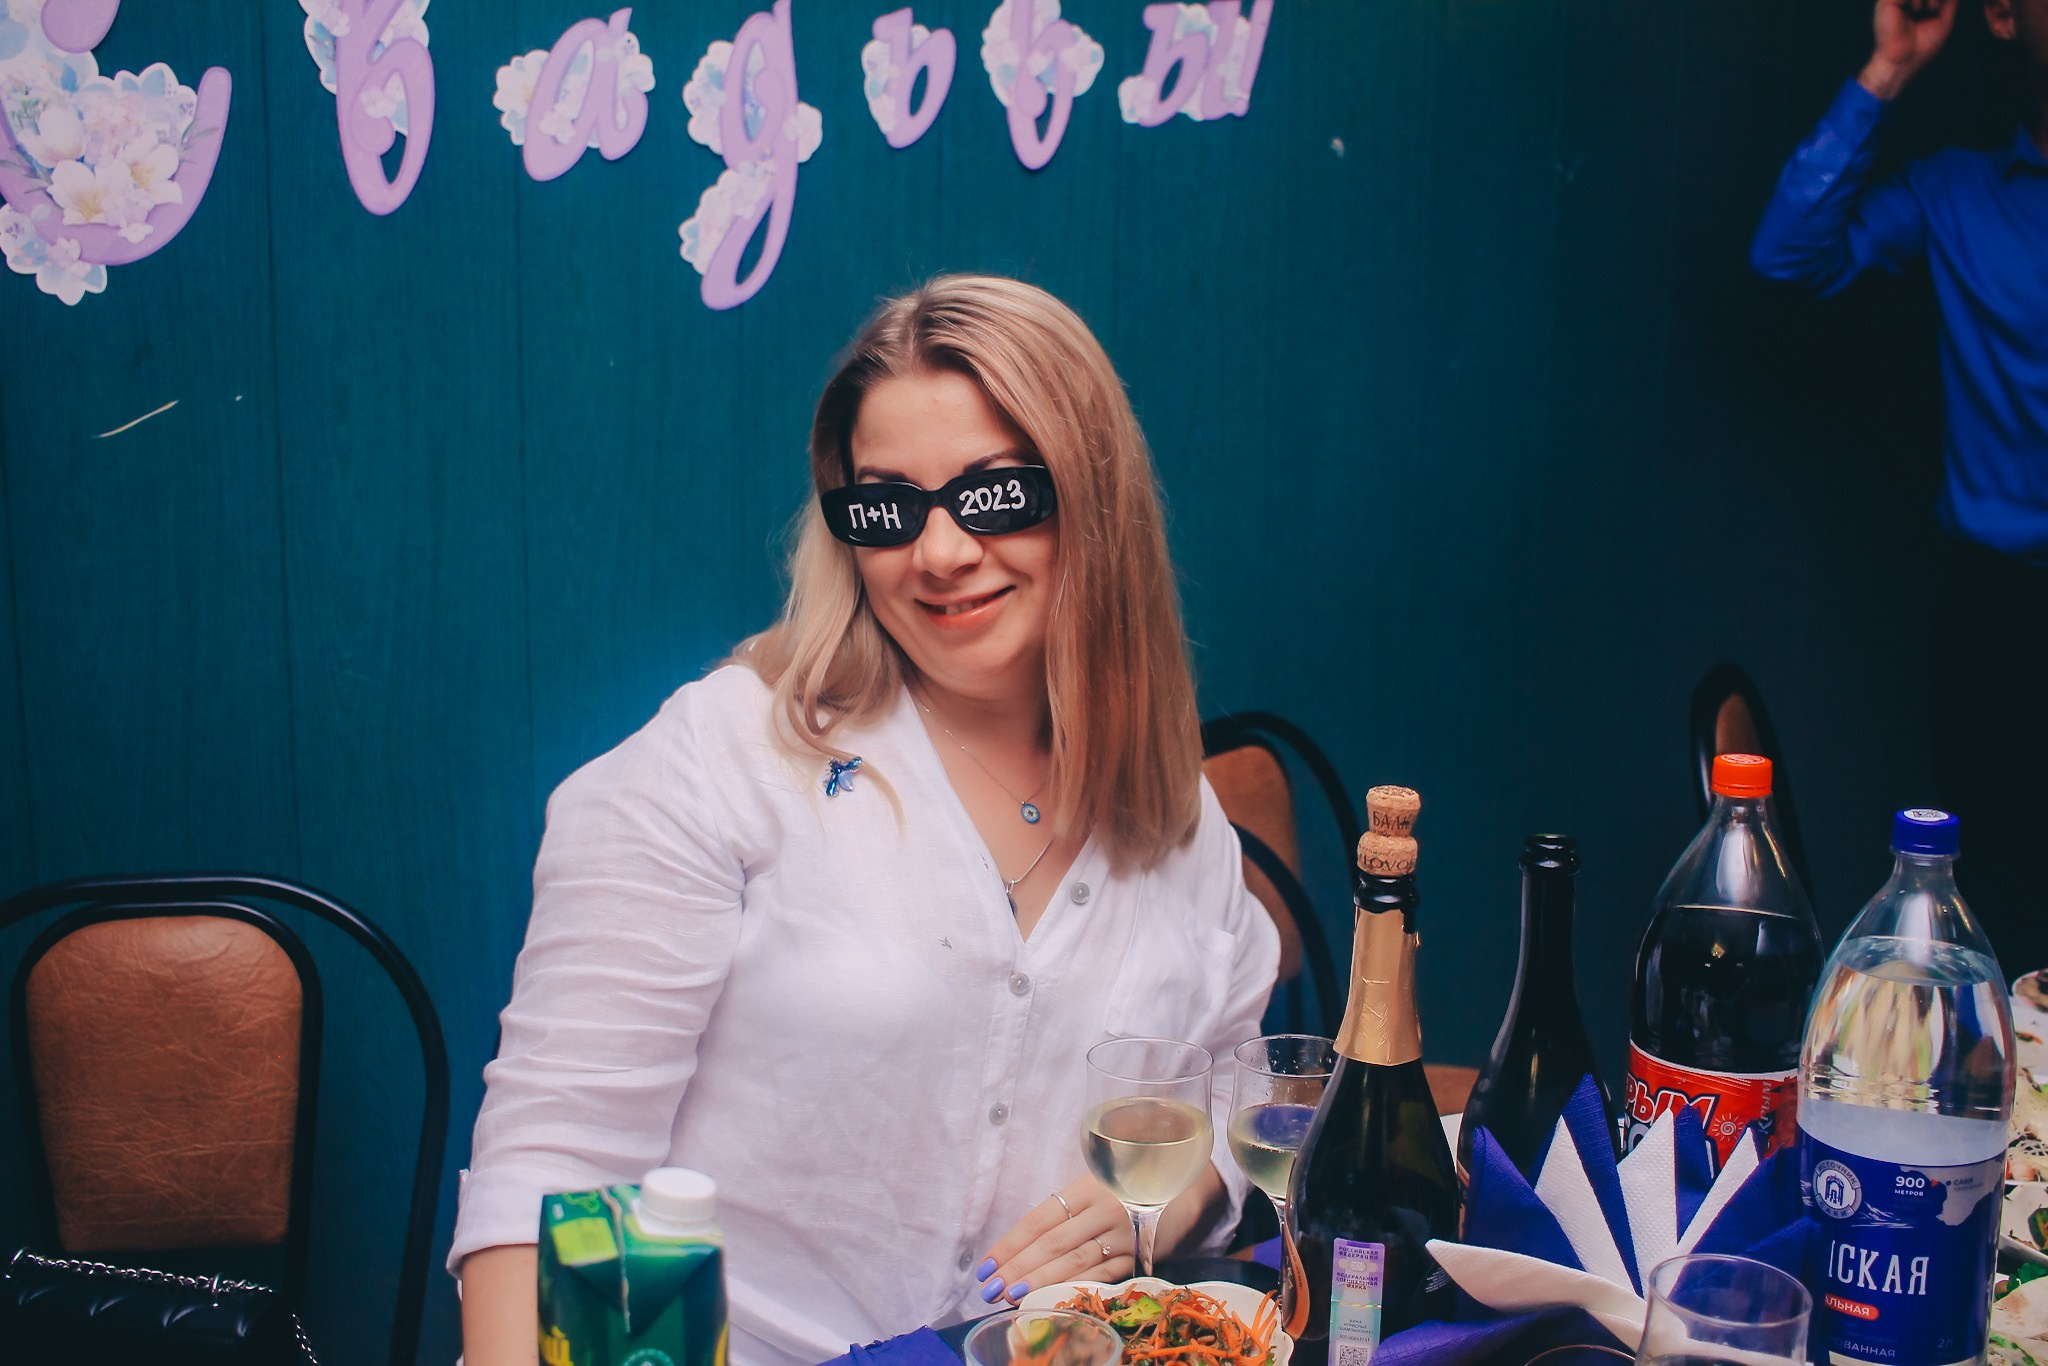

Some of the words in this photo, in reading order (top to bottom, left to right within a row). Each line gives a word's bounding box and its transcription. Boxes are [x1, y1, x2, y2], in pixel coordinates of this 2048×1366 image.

[958, 478, 1027, 517] 2023
[848, 502, 902, 530] П+Н
[1758, 1080, 1772, 1135] КРЫМ
[1818, 1161, 1858, 1186] ИСТОЧНИК
[1895, 1175, 1926, 1189] 900
[1894, 1188, 1924, 1197] МЕТРОВ
[1818, 1202, 1848, 1217] САКИ
[1338, 1246, 1379, 1256] РОССИЙСКАЯ
[1338, 1250, 1379, 1260] ФЕДЕРАЦИЯ
[1336, 1272, 1378, 1281] ФЕДЕРАЛЬНАЯ
[1336, 1277, 1378, 1287] СПЕЦИАЛЬНАЯ
[1833, 1338, 1896, 1358] ОВАННАЯ
